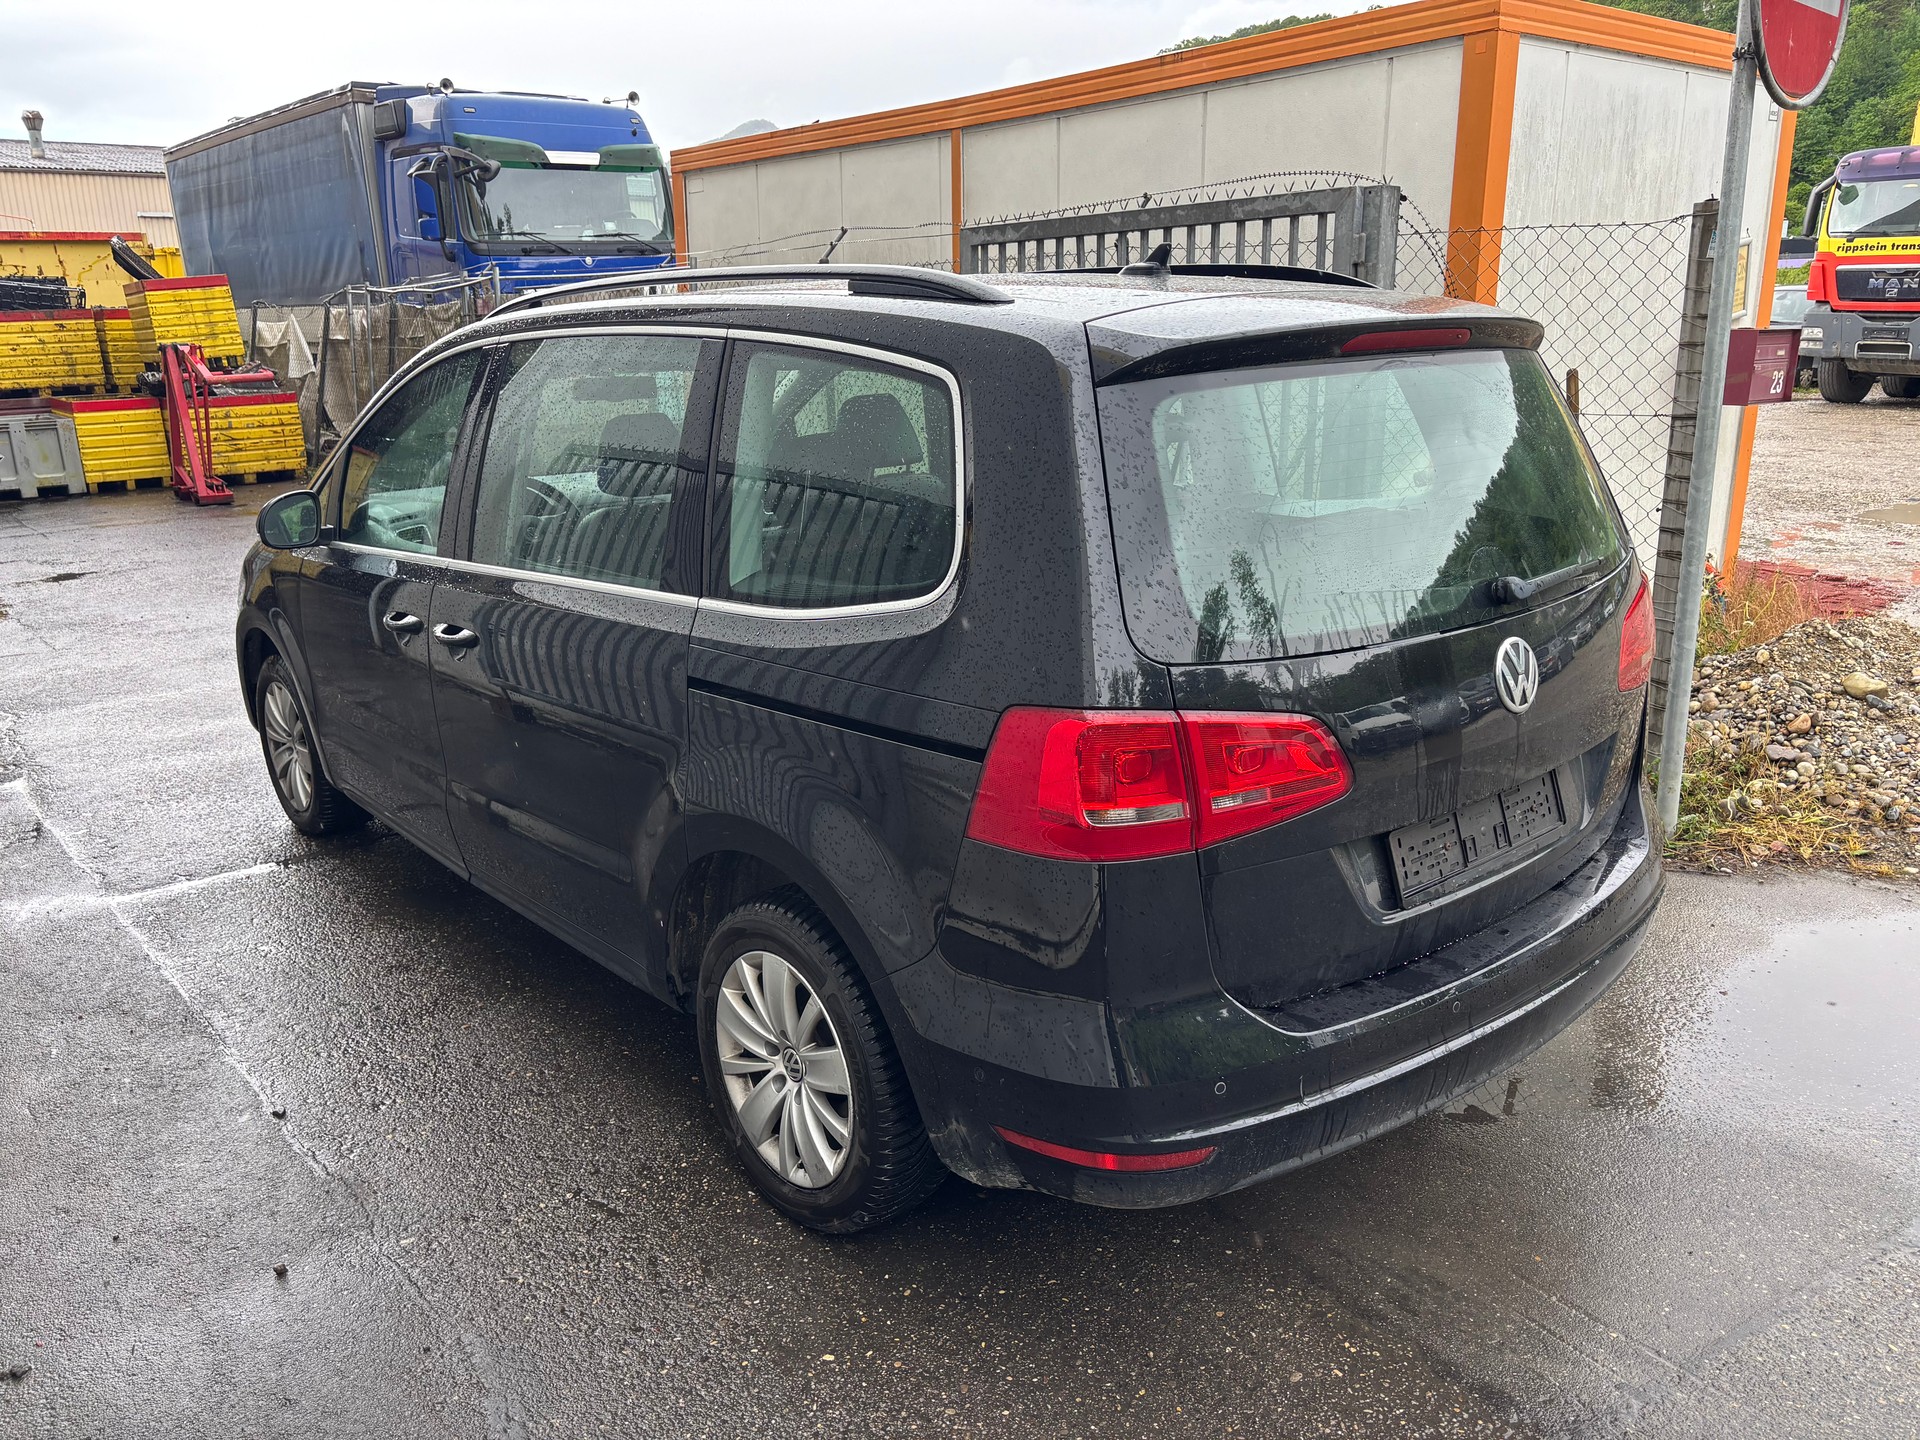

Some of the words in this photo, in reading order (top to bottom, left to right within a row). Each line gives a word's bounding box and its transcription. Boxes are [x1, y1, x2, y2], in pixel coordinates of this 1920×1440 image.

[1837, 242, 1887, 254] rippstein
[1867, 278, 1920, 289] MAN
[1769, 370, 1784, 394] 23
[1496, 636, 1539, 715] VW
